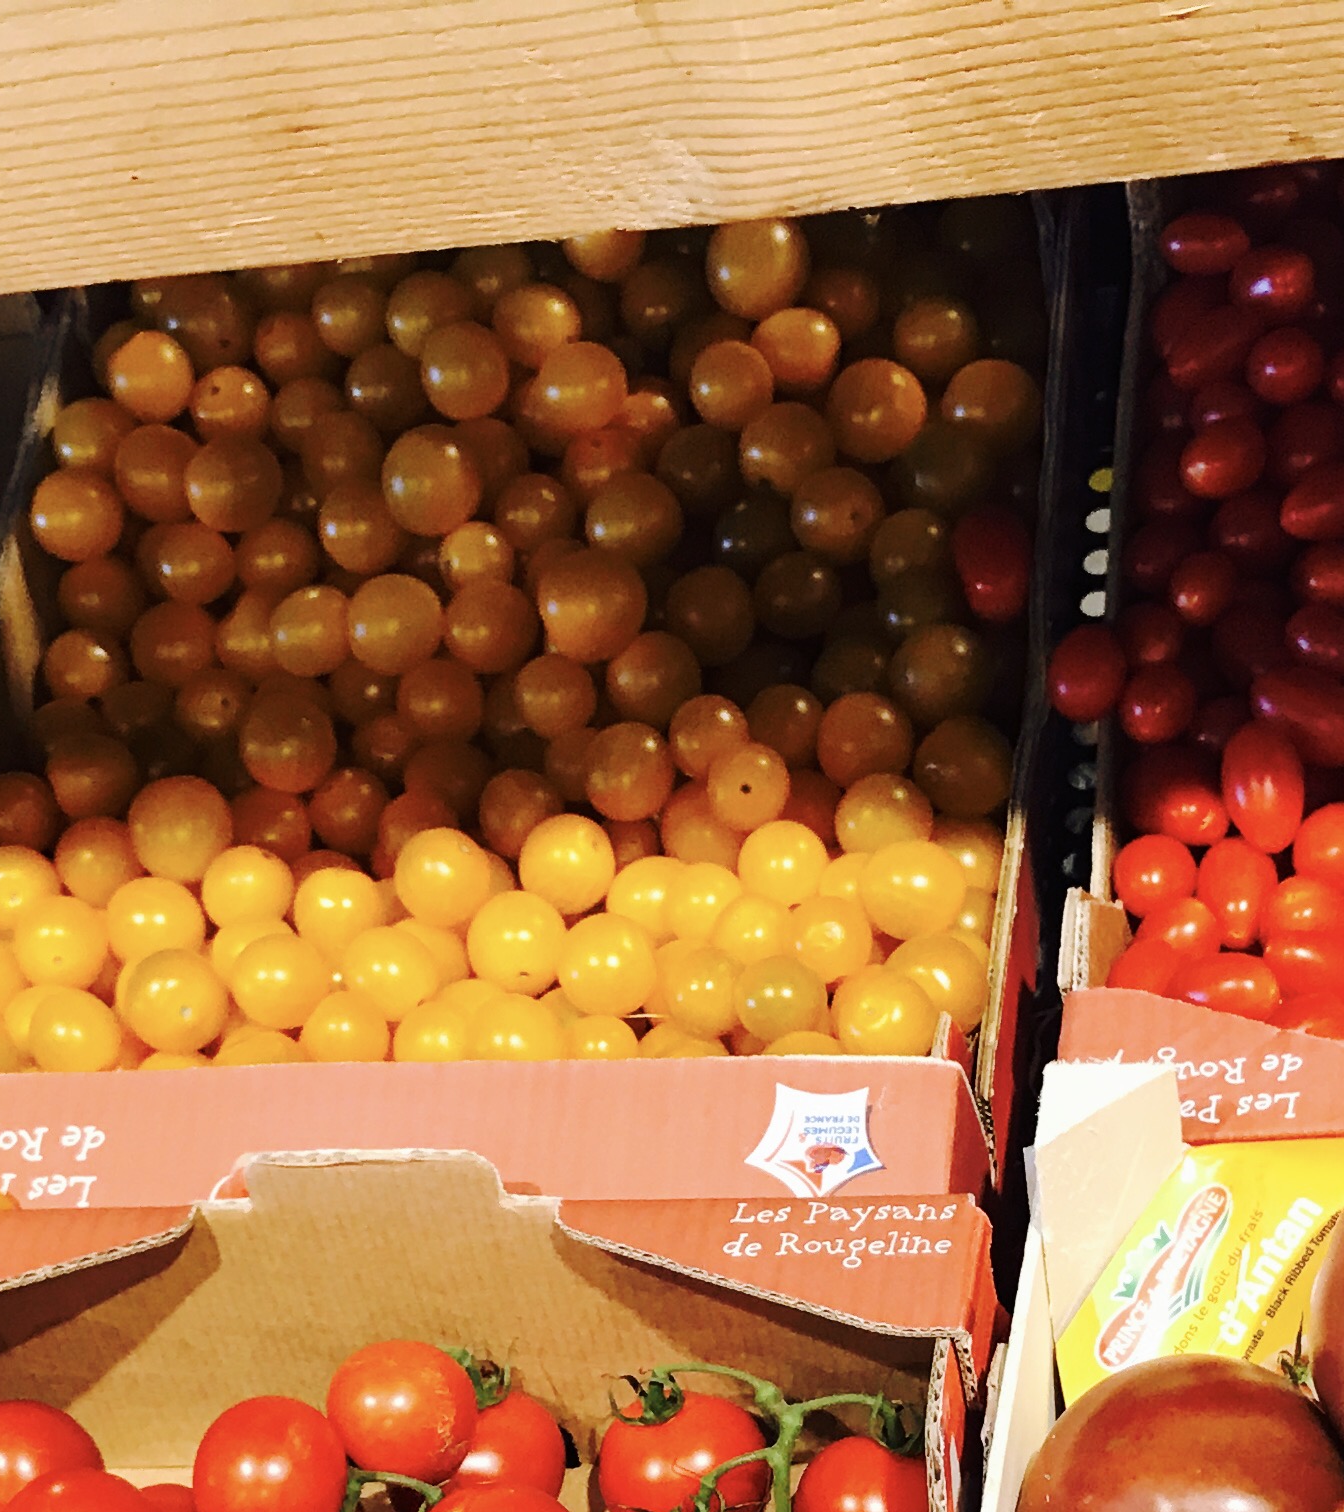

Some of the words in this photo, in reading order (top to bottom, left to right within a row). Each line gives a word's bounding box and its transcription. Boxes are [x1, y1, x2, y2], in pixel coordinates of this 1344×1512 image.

[1261, 1053, 1303, 1081] de
[1237, 1092, 1300, 1118] Les
[59, 1125, 105, 1161] de
[803, 1126, 860, 1135] LEGUMES
[816, 1136, 858, 1145] FRUITS
[27, 1174, 97, 1208] Les
[730, 1202, 792, 1223] Les
[803, 1202, 957, 1231] Paysans
[722, 1233, 763, 1257] de
[775, 1231, 952, 1268] Rougeline
[1266, 1287, 1289, 1319] Black
